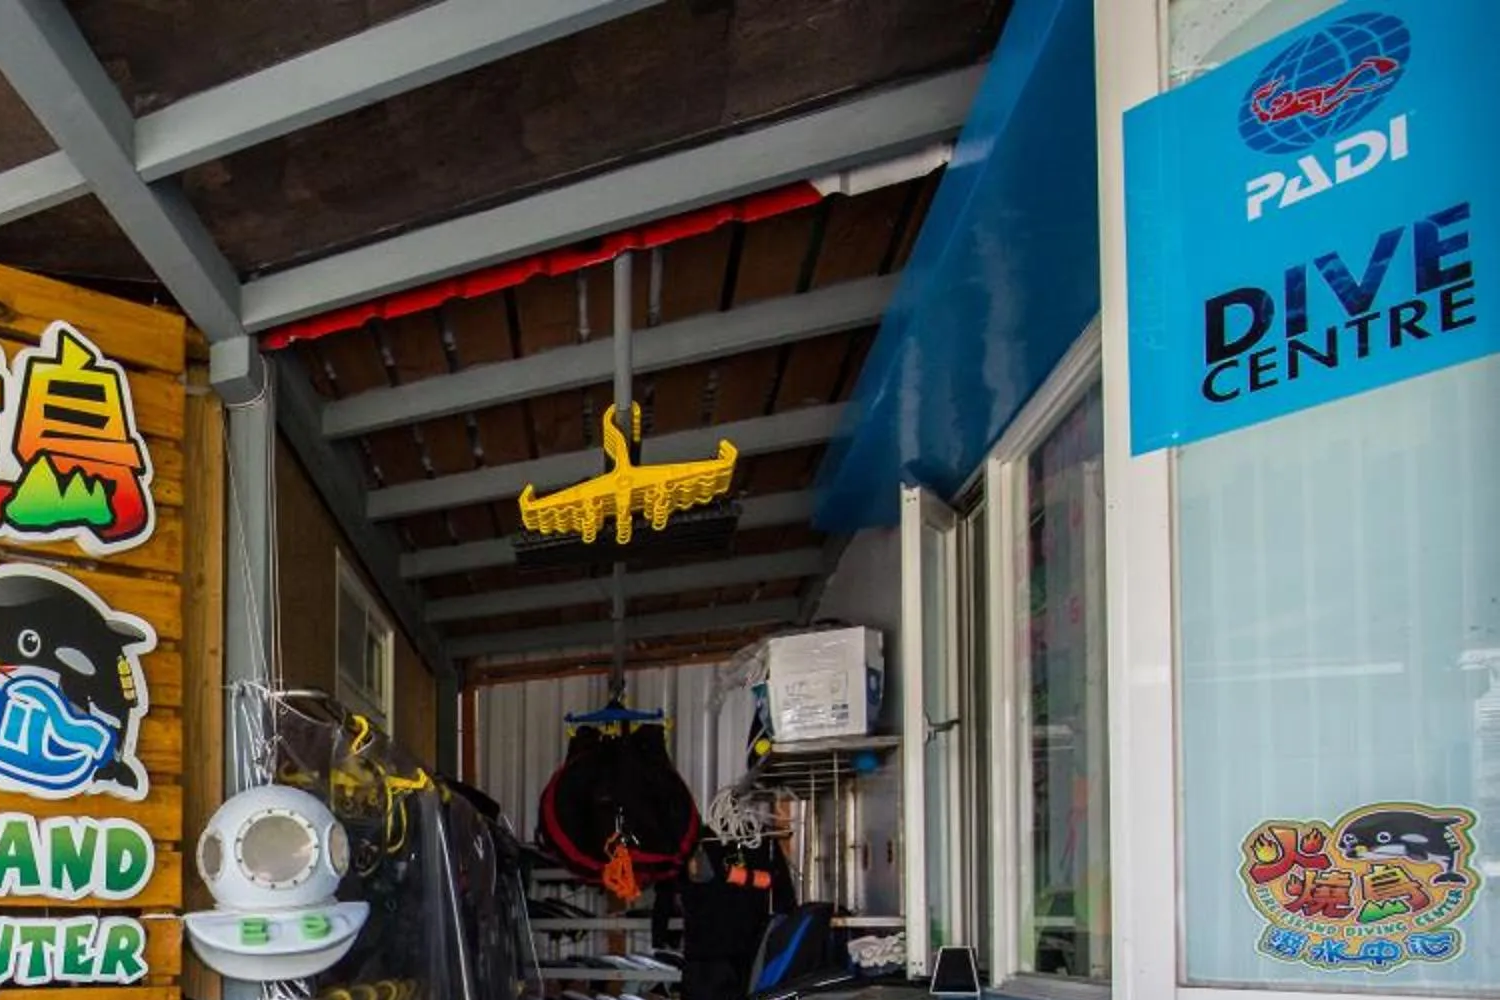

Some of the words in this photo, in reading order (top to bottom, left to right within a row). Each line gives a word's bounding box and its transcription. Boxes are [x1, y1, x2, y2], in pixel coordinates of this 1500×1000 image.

[1246, 114, 1409, 222] PADI
[1204, 201, 1471, 365] DIVE
[1202, 280, 1477, 403] CENTRE
[1345, 922, 1408, 938] DIVING
